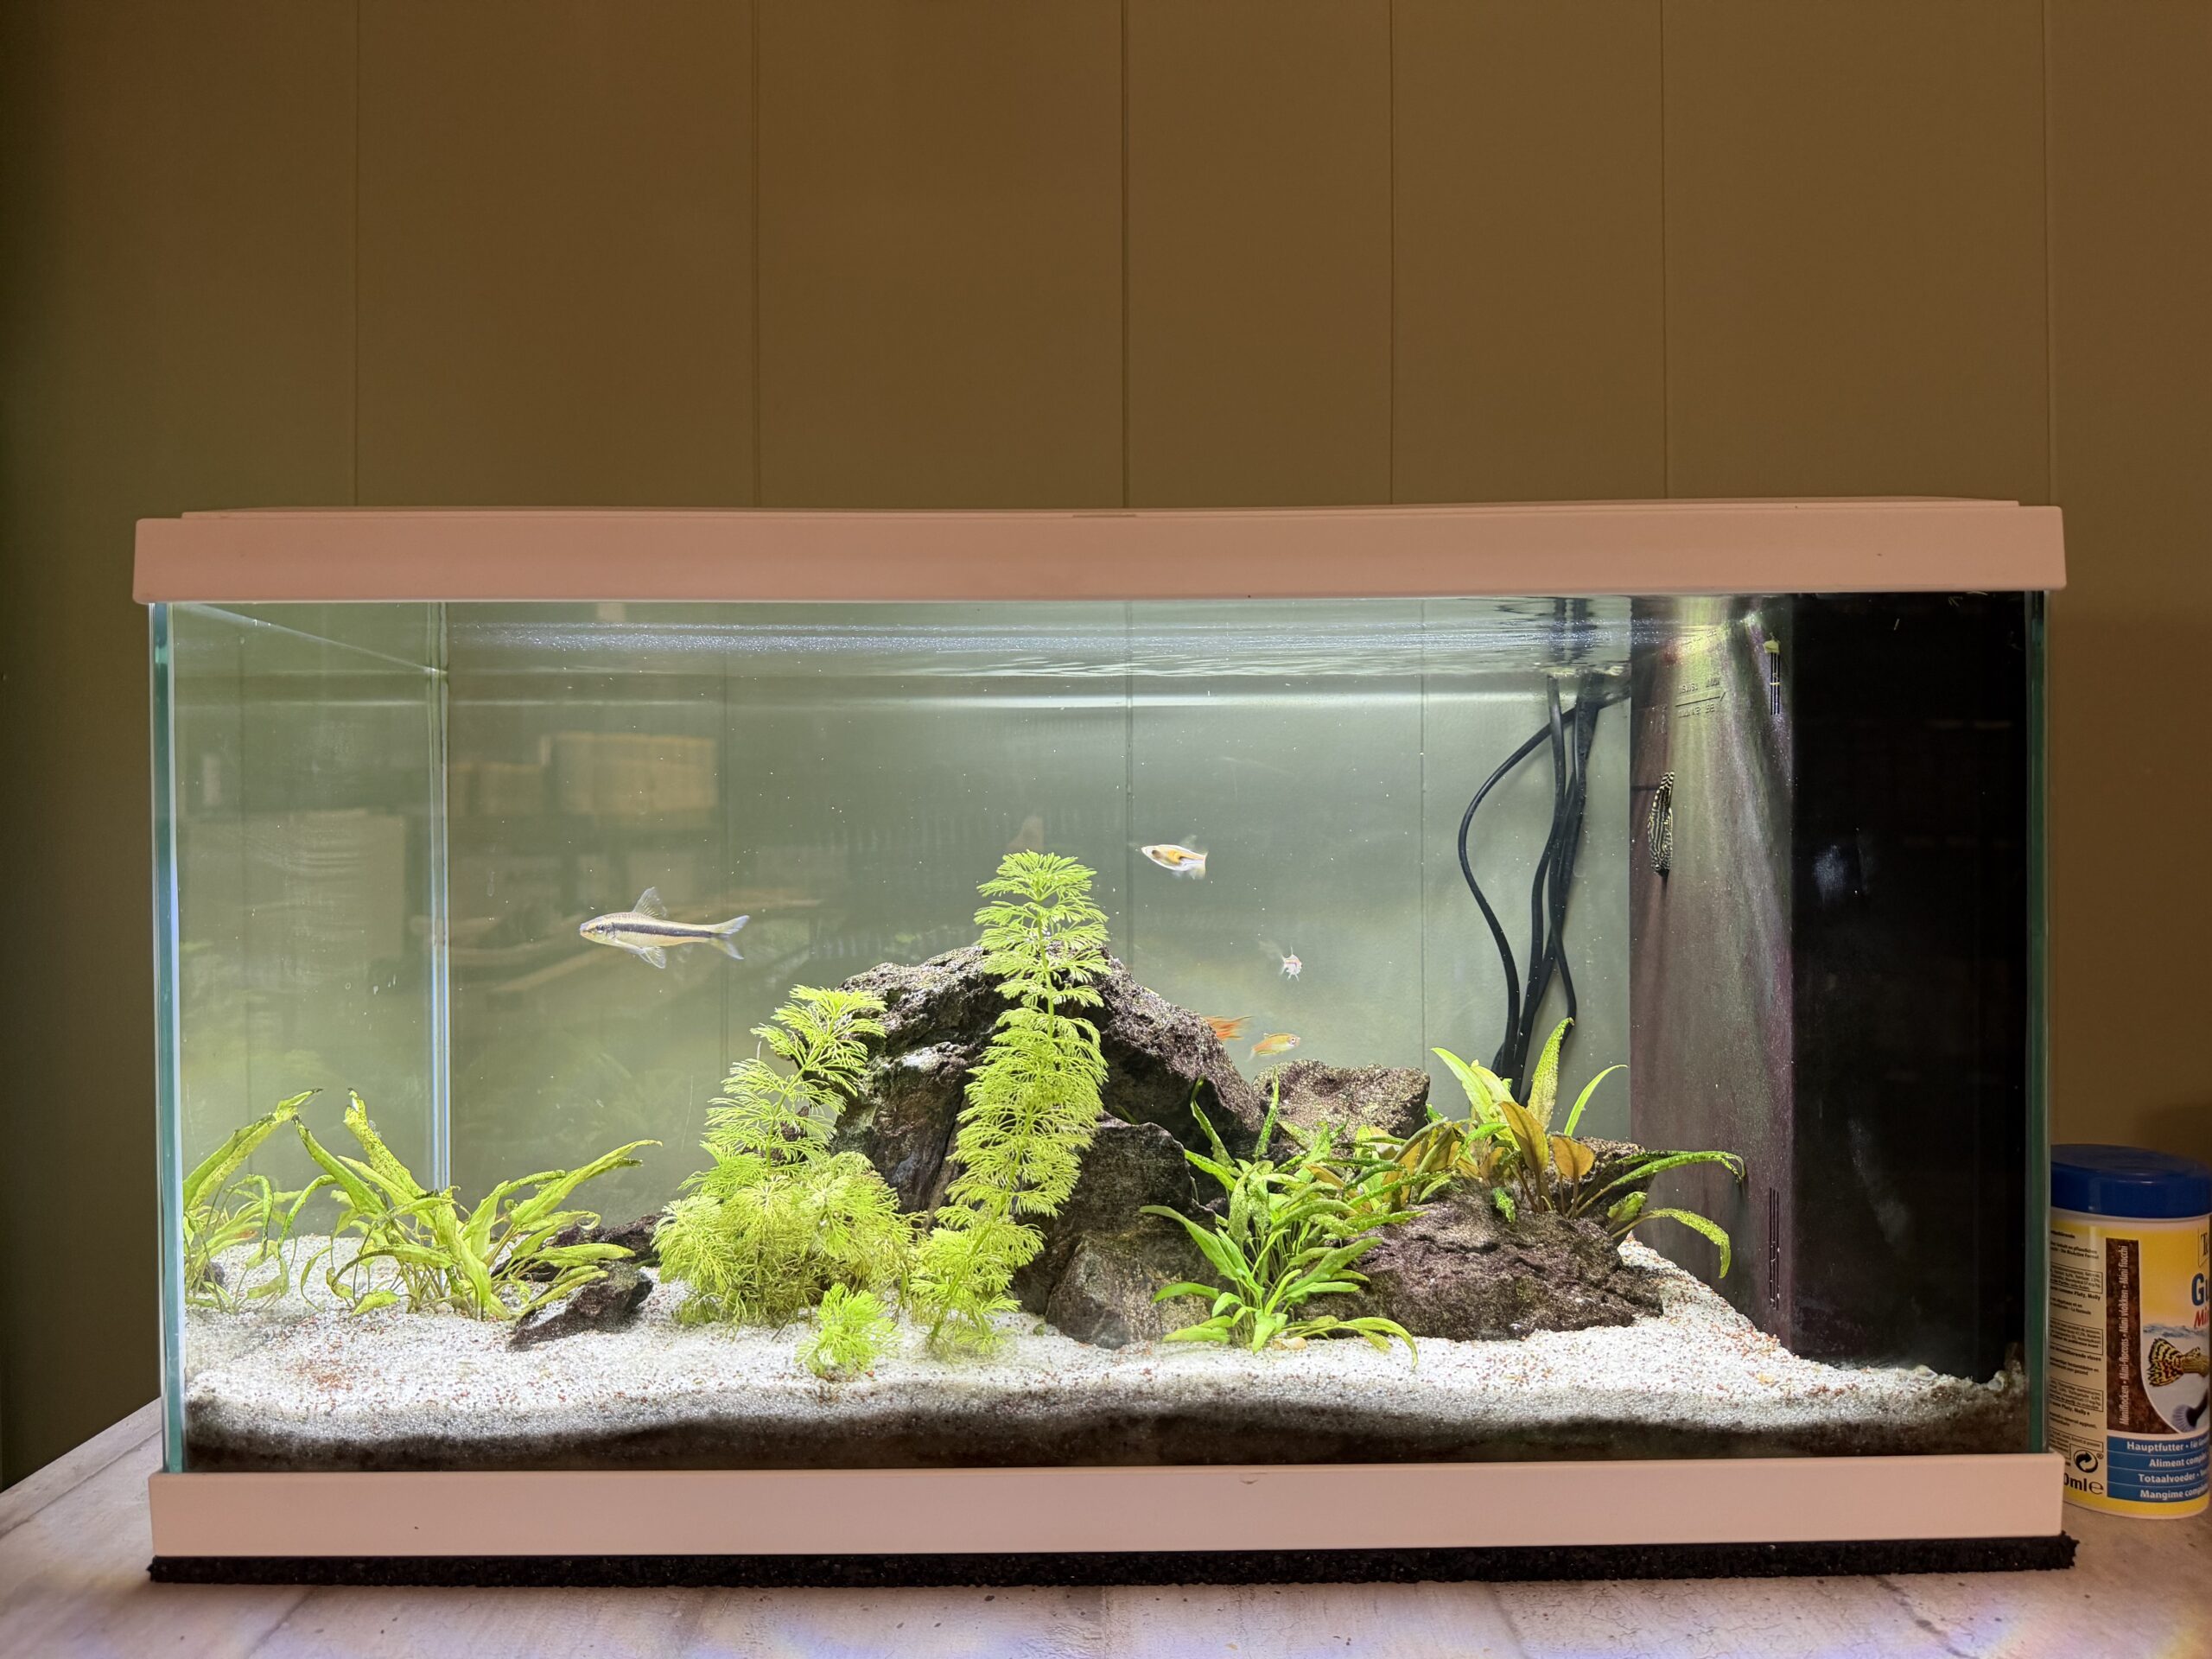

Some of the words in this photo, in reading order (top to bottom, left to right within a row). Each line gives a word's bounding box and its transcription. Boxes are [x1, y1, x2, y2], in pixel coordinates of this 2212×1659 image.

[2118, 1268, 2129, 1284] Mini
[2119, 1317, 2129, 1332] Mini
[2126, 1440, 2183, 1452] Hauptfutter
[2149, 1459, 2184, 1467] Aliment
[2138, 1473, 2196, 1483] Totaalvoeder
[2139, 1490, 2183, 1501] Mangime
